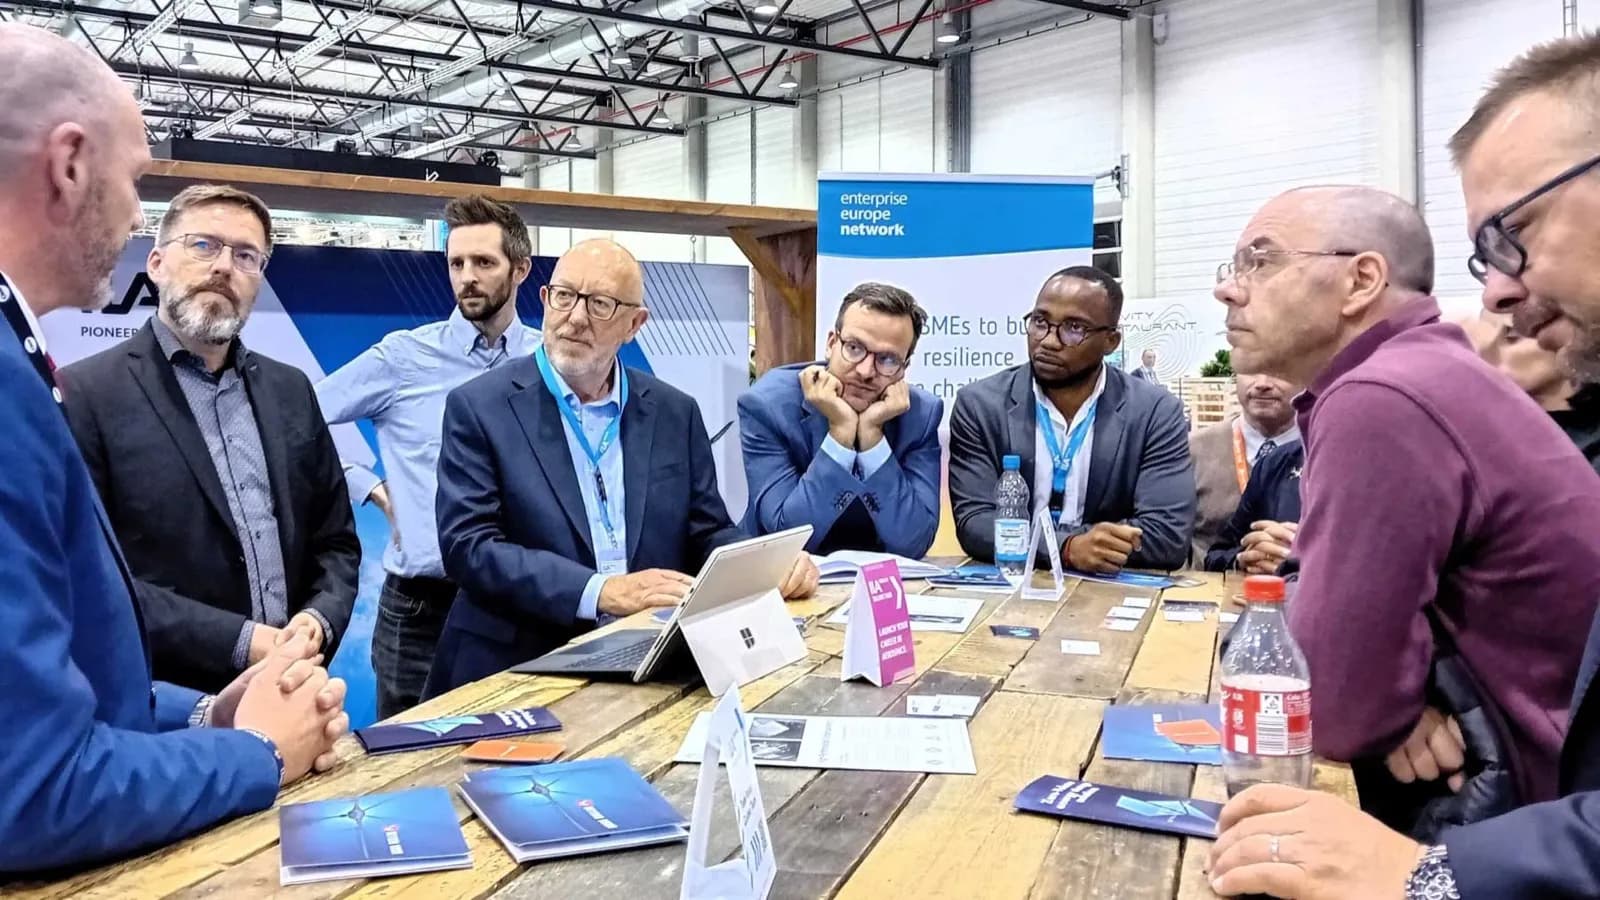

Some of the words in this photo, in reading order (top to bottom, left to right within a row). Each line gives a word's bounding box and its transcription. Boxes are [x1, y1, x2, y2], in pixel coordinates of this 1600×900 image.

[840, 192, 908, 208] enterprise
[840, 209, 891, 224] europe
[840, 223, 905, 236] network
[979, 317, 998, 335] to
[923, 347, 1015, 366] resilience
